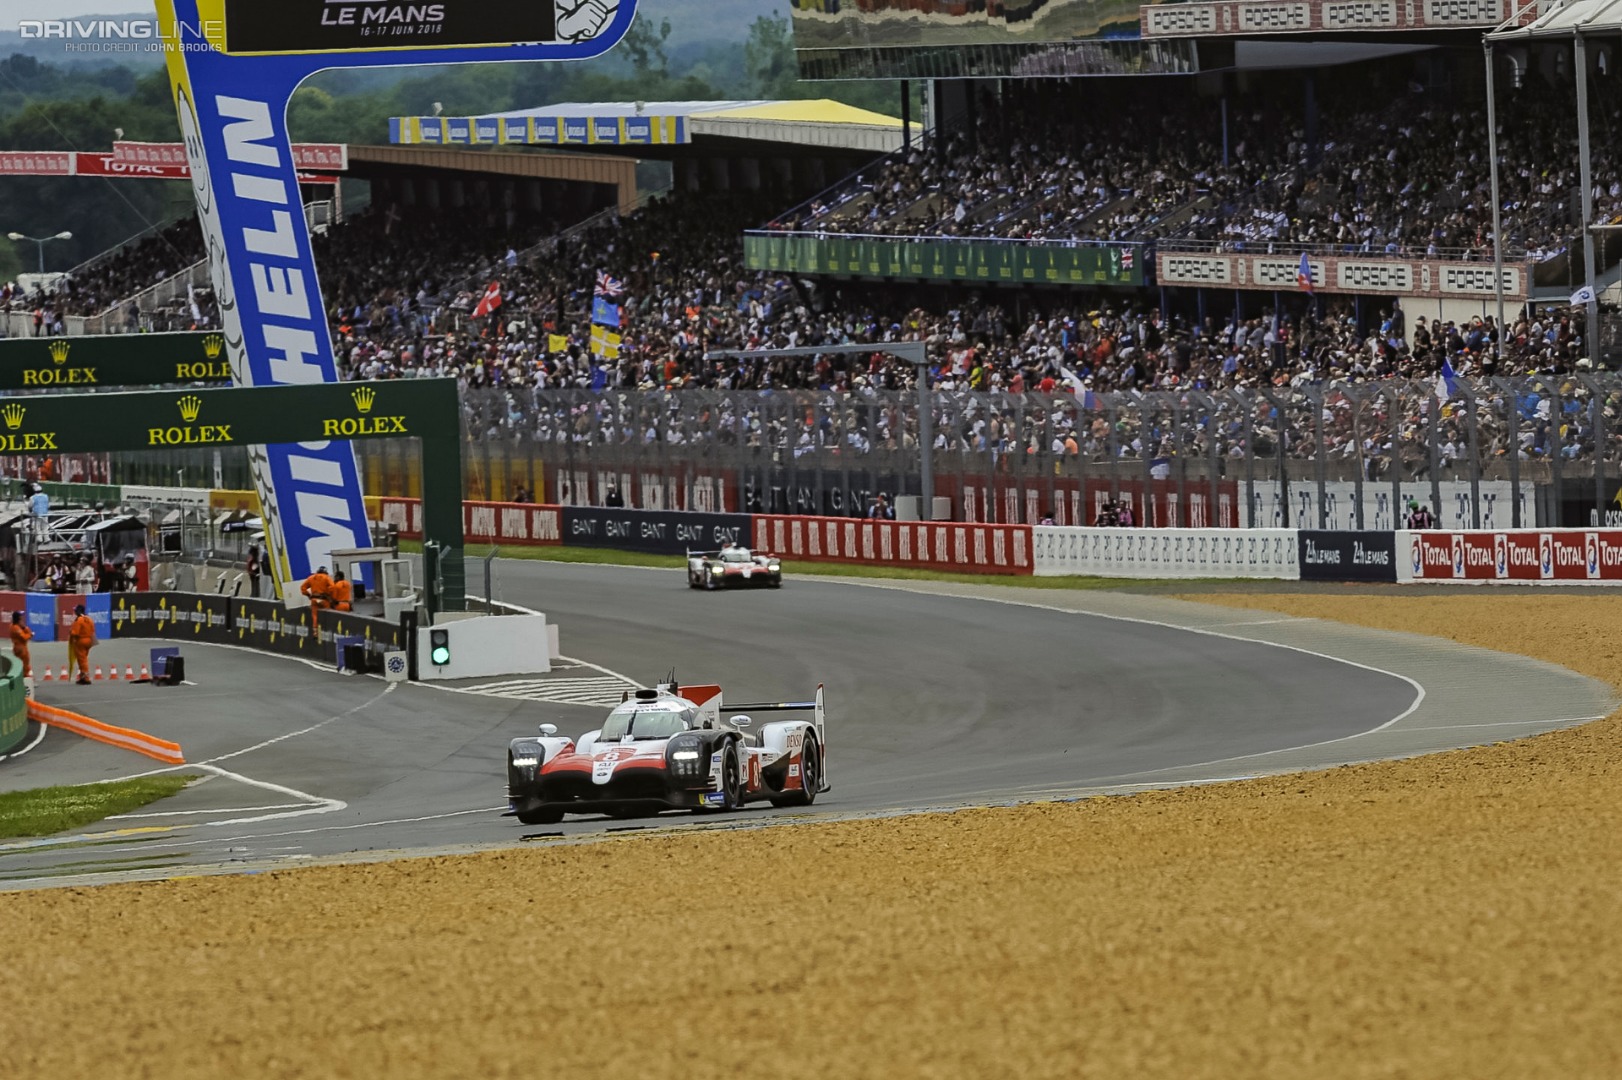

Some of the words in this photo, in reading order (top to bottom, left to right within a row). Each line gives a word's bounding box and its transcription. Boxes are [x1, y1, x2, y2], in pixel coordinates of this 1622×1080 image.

[321, 7, 356, 26] LE
[361, 4, 445, 25] MANS
[1154, 10, 1210, 30] PORSCHE
[1245, 6, 1303, 26] PORSCHE
[1329, 3, 1389, 24] PORSCHE
[1431, 1, 1496, 20] PORSCHE
[360, 26, 387, 36] 16-17
[391, 25, 414, 35] JUIN
[1169, 259, 1225, 279] PORSCHE
[1260, 263, 1319, 283] PORSCE
[1345, 266, 1406, 286] PORSCHE
[215, 95, 363, 582] MIHELIN
[23, 367, 98, 385] ROLEX
[176, 362, 232, 378] ROLE
[148, 425, 233, 445] ROLEX
[323, 415, 408, 437] ROLEX
[572, 518, 597, 536] GANT
[605, 520, 632, 537] GANT
[640, 521, 666, 539] GANT
[676, 523, 704, 541] GANT
[713, 525, 741, 543] GANT
[1423, 542, 1451, 566] TOTAL
[1465, 543, 1494, 566] TOTAL
[1508, 541, 1539, 566] TOTAL
[1554, 541, 1585, 566] TOTAL
[1600, 540, 1622, 566] TOTA
[603, 752, 620, 761] 8
[753, 761, 759, 787] 8
